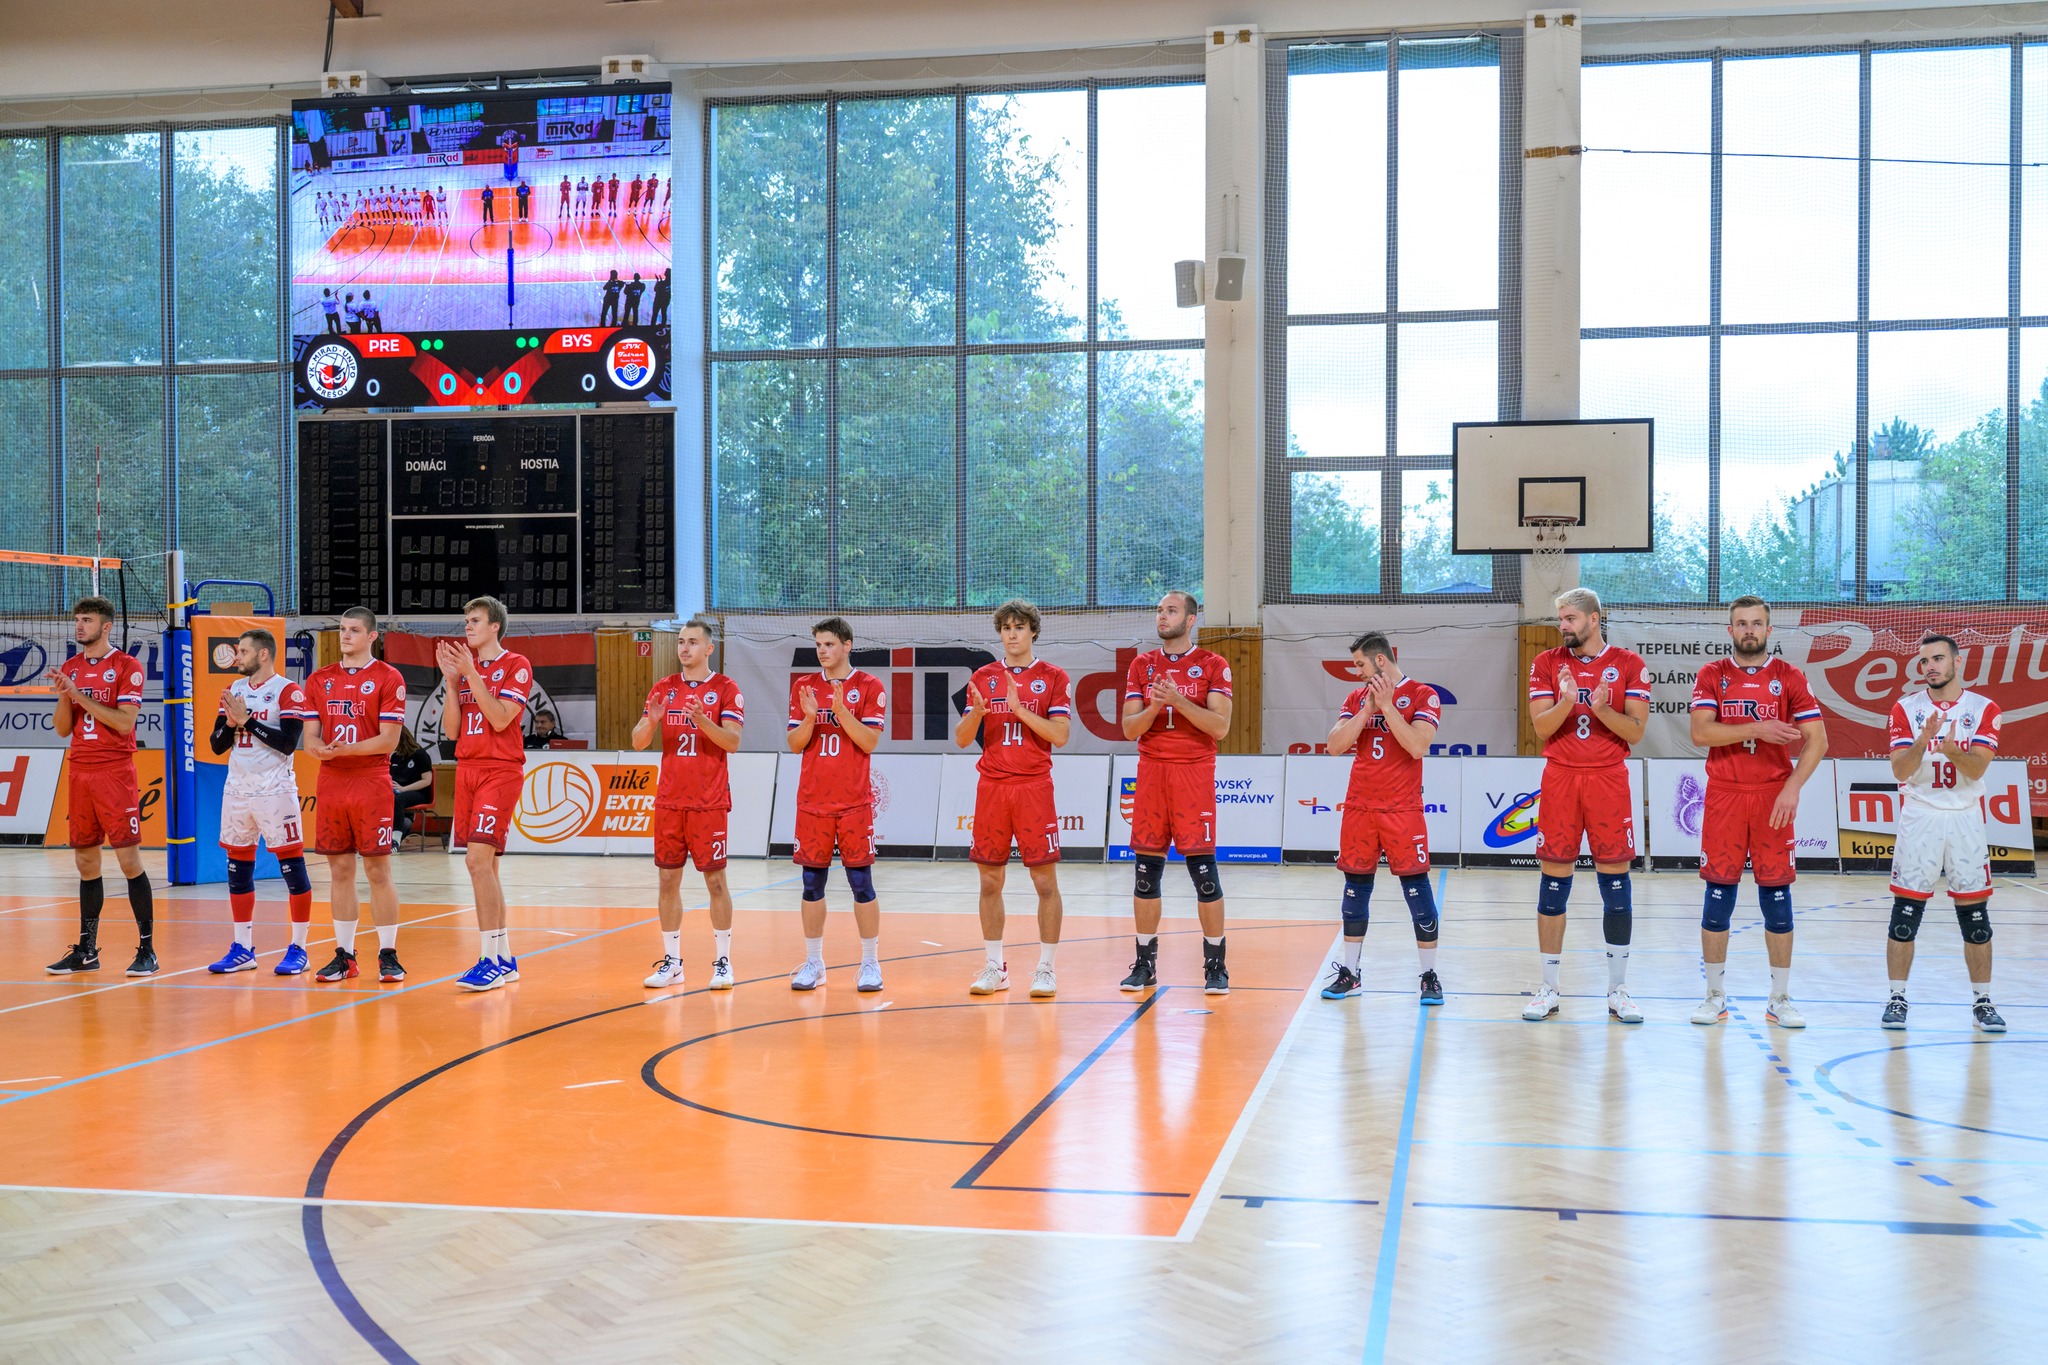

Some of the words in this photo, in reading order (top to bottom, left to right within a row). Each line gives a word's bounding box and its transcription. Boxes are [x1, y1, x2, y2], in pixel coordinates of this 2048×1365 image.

[427, 153, 458, 165] miRad
[369, 339, 400, 353] PRE
[561, 334, 593, 348] BYS
[312, 346, 338, 362] MIRAD
[342, 351, 356, 378] UNIPO
[366, 378, 380, 397] 0
[439, 373, 457, 395] 0
[503, 372, 521, 394] 0
[581, 373, 596, 392] 0
[405, 458, 447, 472] DOMÁCI
[520, 459, 559, 470] HOSTIA
[1637, 641, 1701, 655] TEPELNÉ
[1649, 672, 1697, 685] OLÁRN
[1165, 706, 1175, 729] 1
[1722, 699, 1778, 721] miRad
[83, 712, 96, 733] 9
[466, 711, 484, 735] 12
[1576, 714, 1592, 739] 8
[334, 723, 358, 744] 20
[1002, 722, 1023, 746] 14
[676, 733, 698, 757] 21
[819, 733, 841, 757] 10
[1370, 736, 1385, 760] 5
[609, 768, 650, 790] niké
[1215, 777, 1253, 790] OVSKÝ
[1931, 761, 1957, 788] 19
[605, 794, 656, 811] EXTR
[1215, 792, 1275, 804] SPRÁVNY
[129, 817, 140, 835] 9
[284, 822, 300, 843] 11
[475, 813, 497, 835] 12
[602, 812, 651, 832] MUŽI
[1203, 822, 1212, 842] 1
[378, 826, 392, 846] 20
[1626, 828, 1634, 849] 8
[1794, 837, 1828, 849] rketing
[712, 840, 727, 861] 21
[1228, 853, 1268, 861] www.vucpo.sk
[1416, 843, 1427, 864] 5
